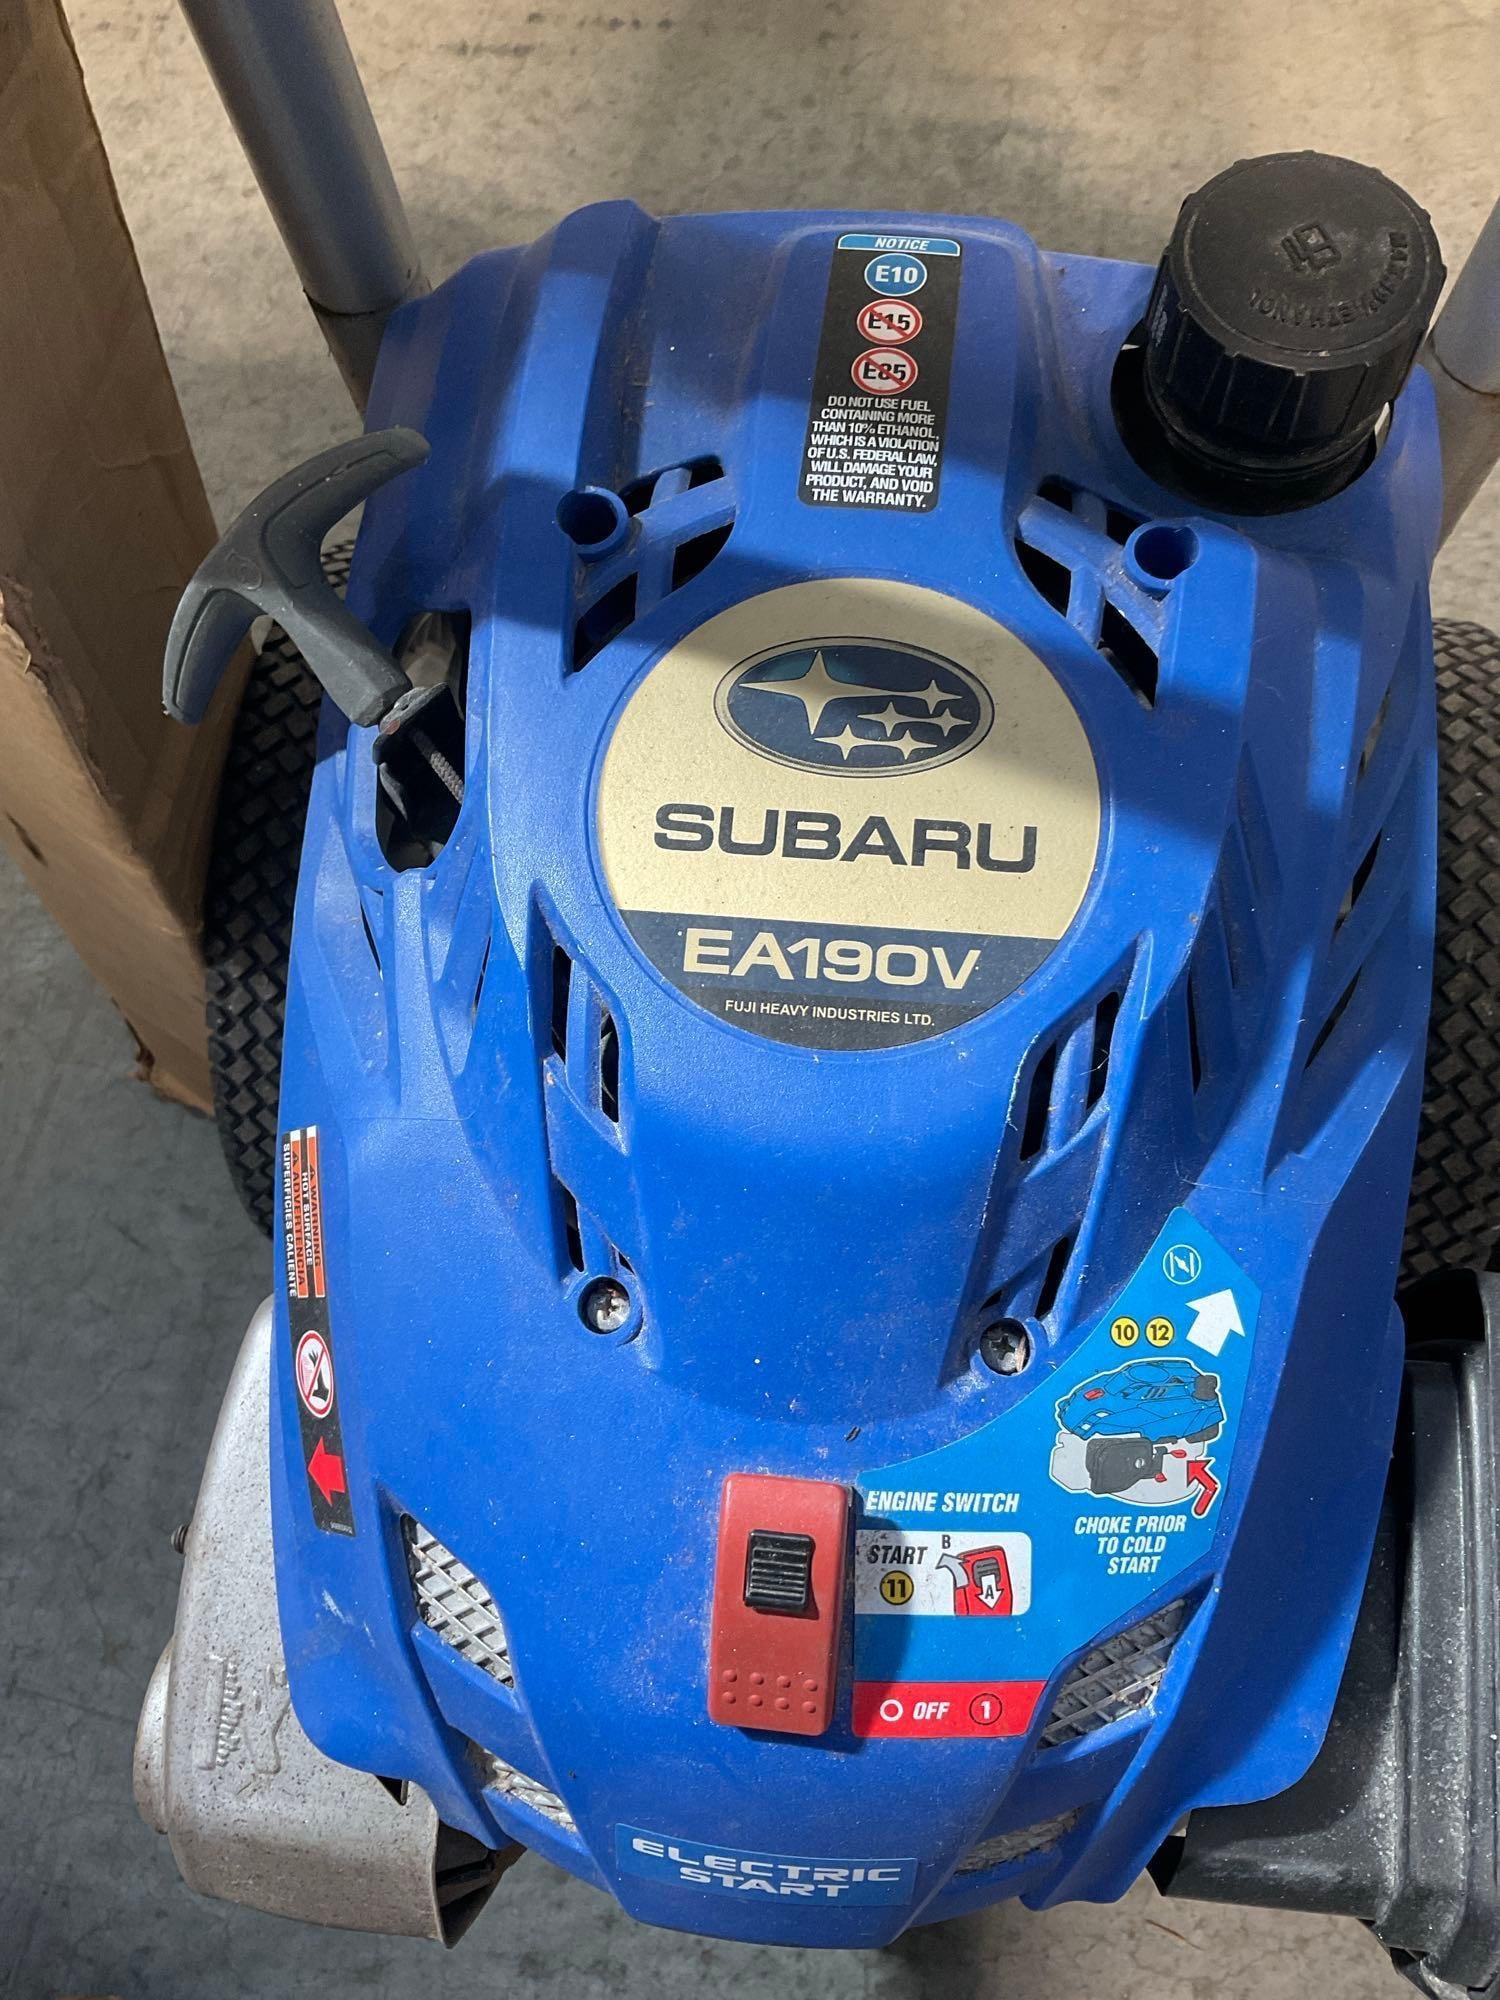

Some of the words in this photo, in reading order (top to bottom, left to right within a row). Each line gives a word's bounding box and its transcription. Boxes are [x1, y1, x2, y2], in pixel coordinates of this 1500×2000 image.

[875, 237, 930, 251] NOTICE
[875, 265, 918, 284] E10
[868, 312, 911, 331] E15
[863, 361, 907, 381] E85
[828, 395, 846, 407] DO
[848, 396, 872, 408] NOT
[875, 398, 899, 409] USE
[901, 399, 931, 412] FUEL
[821, 408, 895, 422] CONTAINING
[897, 412, 936, 426] MORE
[812, 421, 846, 433] THAN
[849, 423, 875, 435] 10%
[877, 424, 940, 440] ETHANOL,
[811, 434, 855, 447] WHICH
[854, 436, 866, 447] IS
[866, 436, 876, 448] A
[879, 437, 940, 452] VIOLATION
[807, 447, 825, 459] OF
[826, 447, 850, 460] U.S.
[853, 449, 906, 464] FEDERAL
[909, 453, 938, 467] LAW,
[811, 460, 843, 473] WILL
[843, 461, 896, 476] DAMAGE
[898, 465, 933, 479] YOUR
[805, 474, 867, 490] PRODUCT,
[870, 478, 899, 492] AND
[902, 479, 934, 493] VOID
[812, 488, 838, 502] THE
[843, 489, 926, 508] WARRANTY.
[654, 802, 1038, 873] SUBARU
[683, 928, 981, 989] EA190V
[725, 999, 757, 1015] FUJI
[760, 1002, 809, 1017] HEAVY
[812, 1005, 901, 1024] INDUSTRIES
[903, 1012, 936, 1027] LTD.
[283, 1143, 293, 1229] SUPERFICIES
[301, 1172, 309, 1199] HOT
[292, 1173, 307, 1286] ADVERTENCIA
[303, 1203, 313, 1266] SURFACE
[309, 1187, 322, 1267] WARNING
[286, 1234, 298, 1298] CALIENTE
[1115, 1324, 1135, 1341] 10
[1150, 1324, 1170, 1341] 12
[866, 1490, 938, 1512] ENGINE
[941, 1492, 1020, 1513] SWITCH
[1074, 1516, 1132, 1535] CHOKE
[1135, 1515, 1187, 1533] PRIOR
[942, 1535, 951, 1549] B
[1097, 1537, 1119, 1555] TO
[1122, 1535, 1166, 1554] COLD
[866, 1544, 928, 1564] START
[1107, 1556, 1161, 1575] START
[886, 1579, 907, 1598] 11
[985, 1587, 995, 1600] A
[913, 1702, 950, 1720] OFF
[980, 1701, 992, 1719] 1
[632, 1837, 901, 1882] ELECTRIC
[679, 1866, 850, 1897] START
